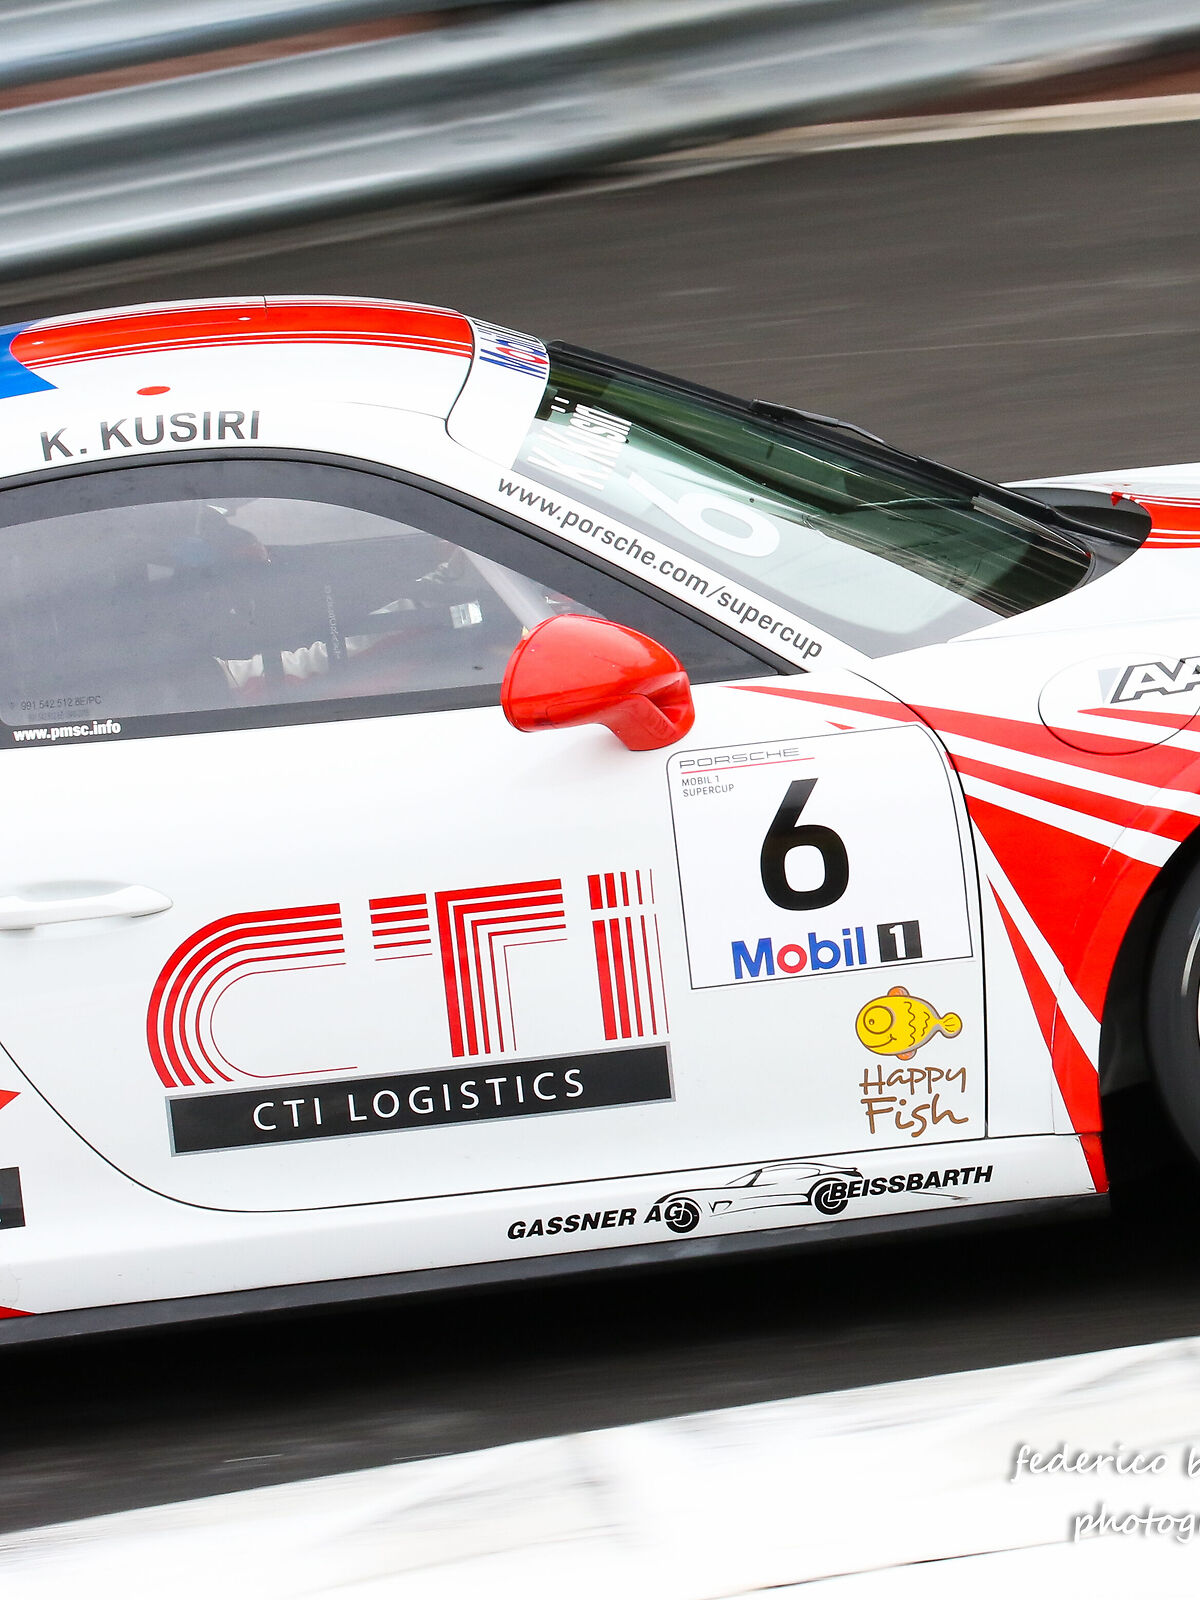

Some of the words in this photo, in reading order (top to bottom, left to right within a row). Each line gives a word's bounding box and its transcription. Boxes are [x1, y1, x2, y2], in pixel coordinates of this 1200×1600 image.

[40, 428, 88, 461] K.
[100, 410, 260, 450] KUSIRI
[627, 471, 781, 557] 6
[497, 477, 823, 660] www.porsche.com/supercup
[13, 720, 122, 741] www.pmsc.info
[680, 747, 800, 769] PORSCHE
[682, 776, 711, 787] MOBIL
[714, 775, 720, 783] 1
[683, 784, 735, 798] SUPERCUP
[760, 777, 850, 911] 6
[731, 926, 868, 980] Mobil
[253, 1097, 323, 1131] CTI
[348, 1069, 585, 1123] LOGISTICS
[859, 1064, 967, 1096] Happy
[860, 1094, 969, 1138] Fish
[506, 1207, 637, 1240] GASSNER
[644, 1204, 688, 1224] AG
[829, 1165, 993, 1201] BEISSBARTH
